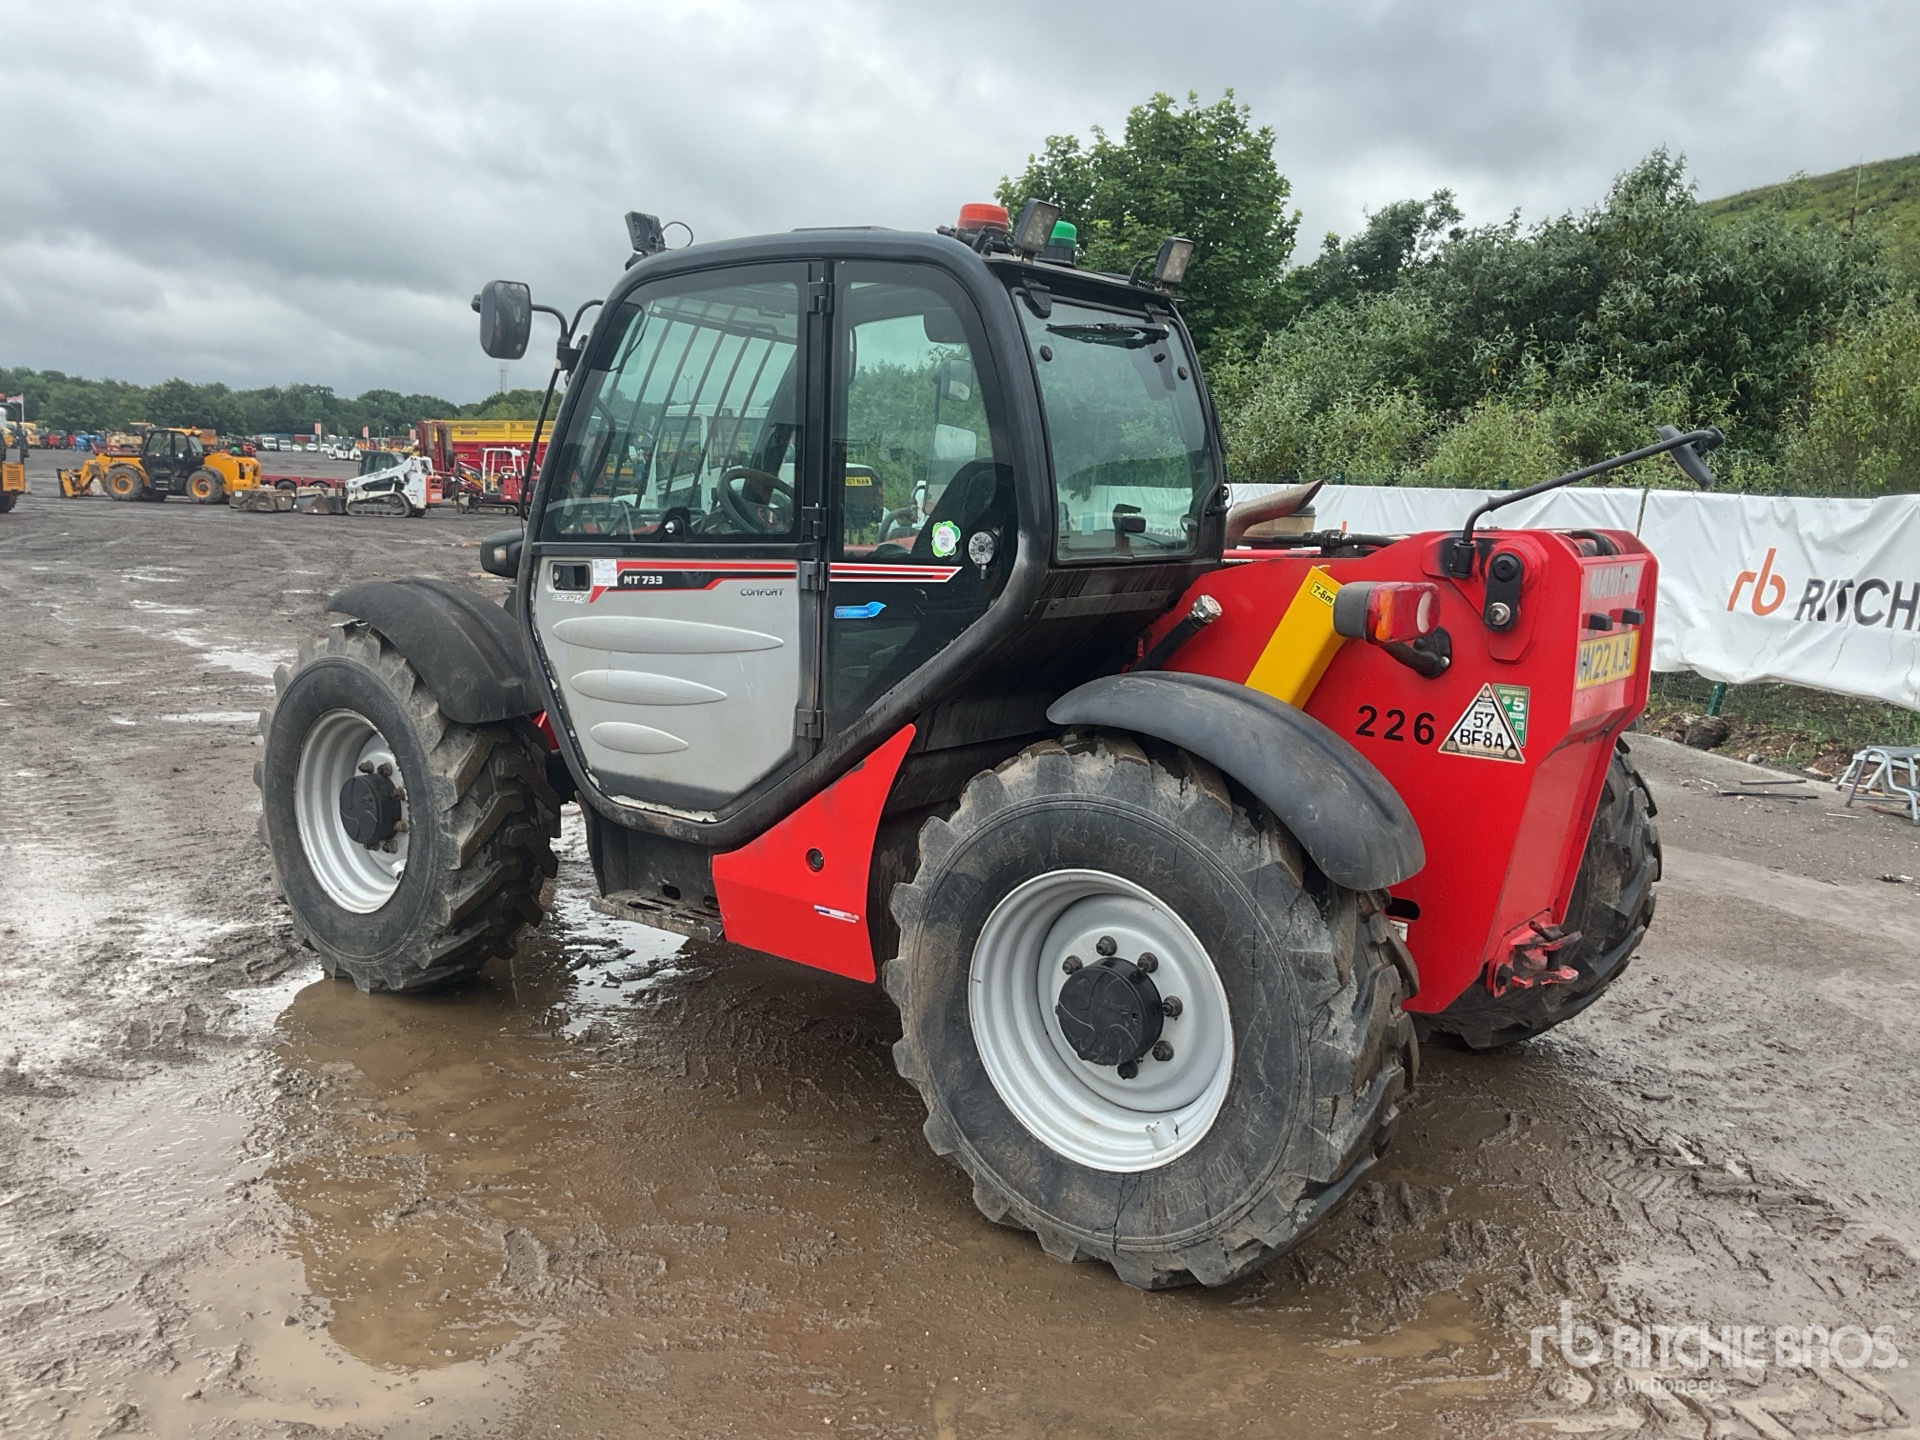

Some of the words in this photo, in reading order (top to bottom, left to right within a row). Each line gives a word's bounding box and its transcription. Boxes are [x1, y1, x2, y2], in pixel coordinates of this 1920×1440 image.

[623, 575, 640, 585] MT
[642, 575, 663, 585] 733
[1590, 565, 1640, 600] MANITOU
[740, 588, 785, 596] COMFORT
[1794, 578, 1920, 632] RITCH
[1512, 696, 1525, 712] 5
[1355, 705, 1436, 746] 226
[1473, 711, 1495, 728] 57
[1460, 729, 1504, 750] BF8A
